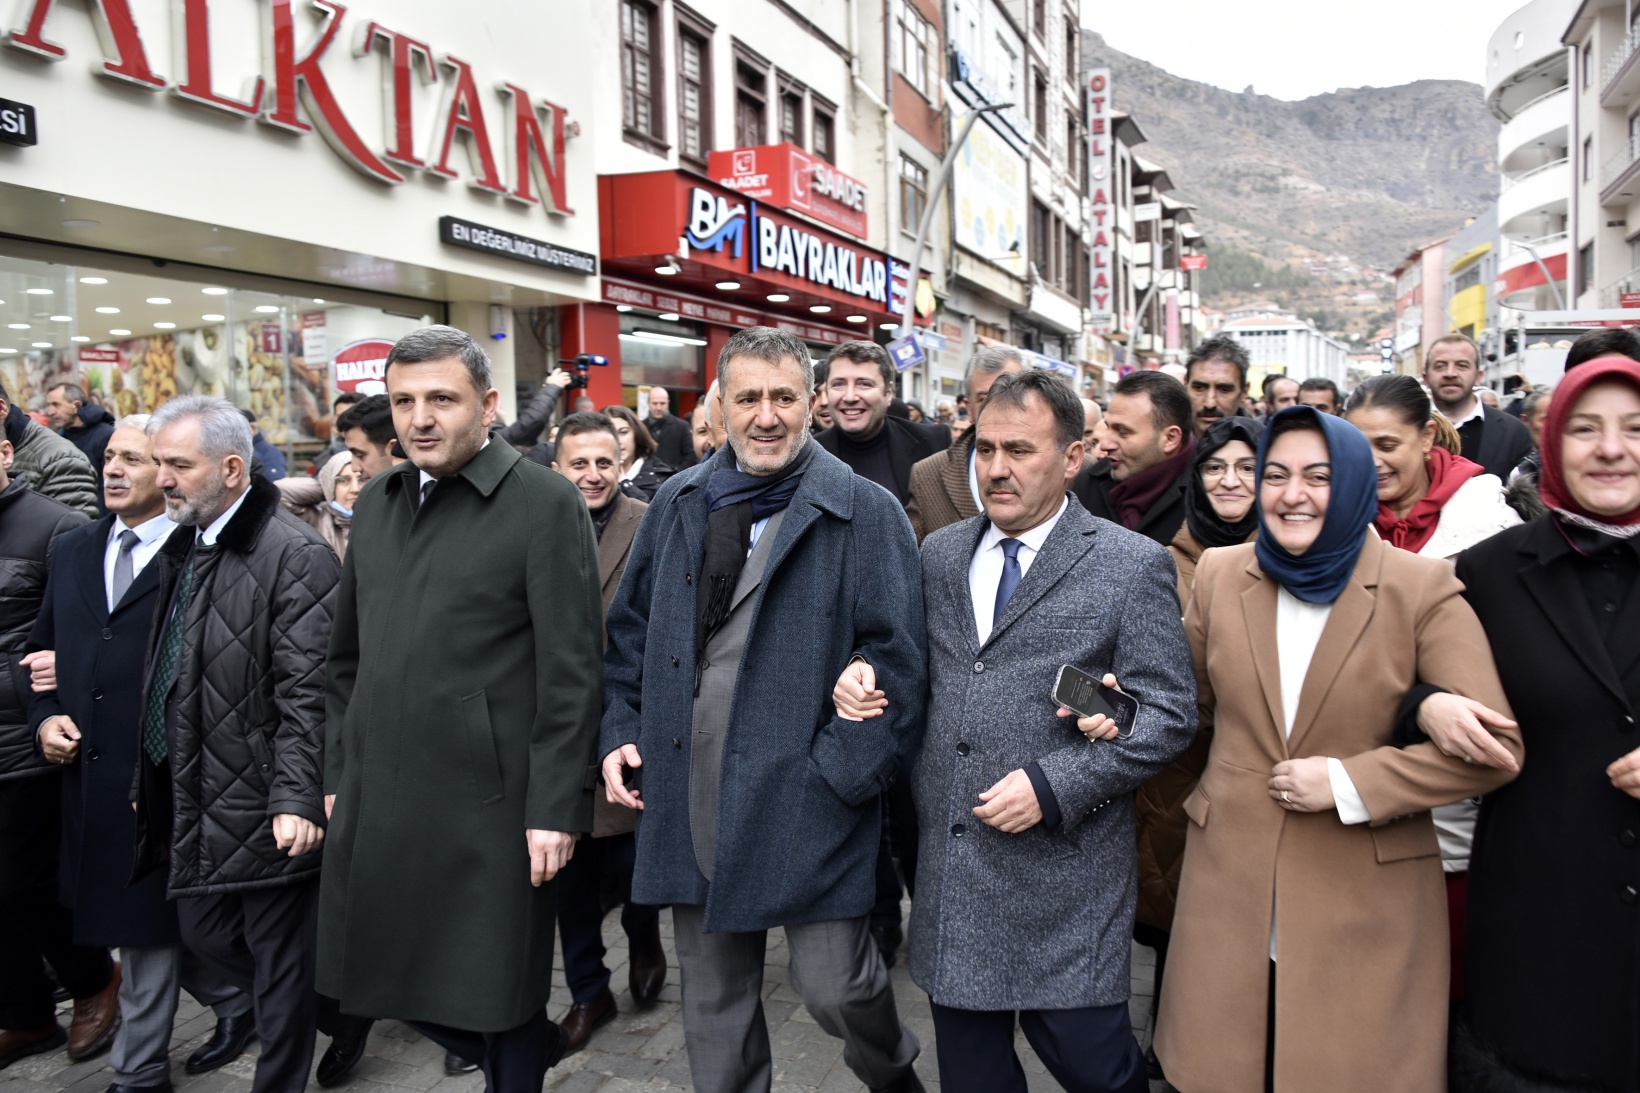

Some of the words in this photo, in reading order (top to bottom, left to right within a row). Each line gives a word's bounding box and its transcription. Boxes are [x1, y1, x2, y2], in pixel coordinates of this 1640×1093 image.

[0, 107, 27, 136] Sİ
[1090, 74, 1107, 157] OTEL
[719, 174, 769, 190] SAADET
[815, 163, 869, 211] SAADET
[452, 223, 470, 240] EN
[1091, 187, 1110, 311] ATALAY
[758, 215, 887, 303] BAYRAKLAR
[267, 333, 278, 351] 1
